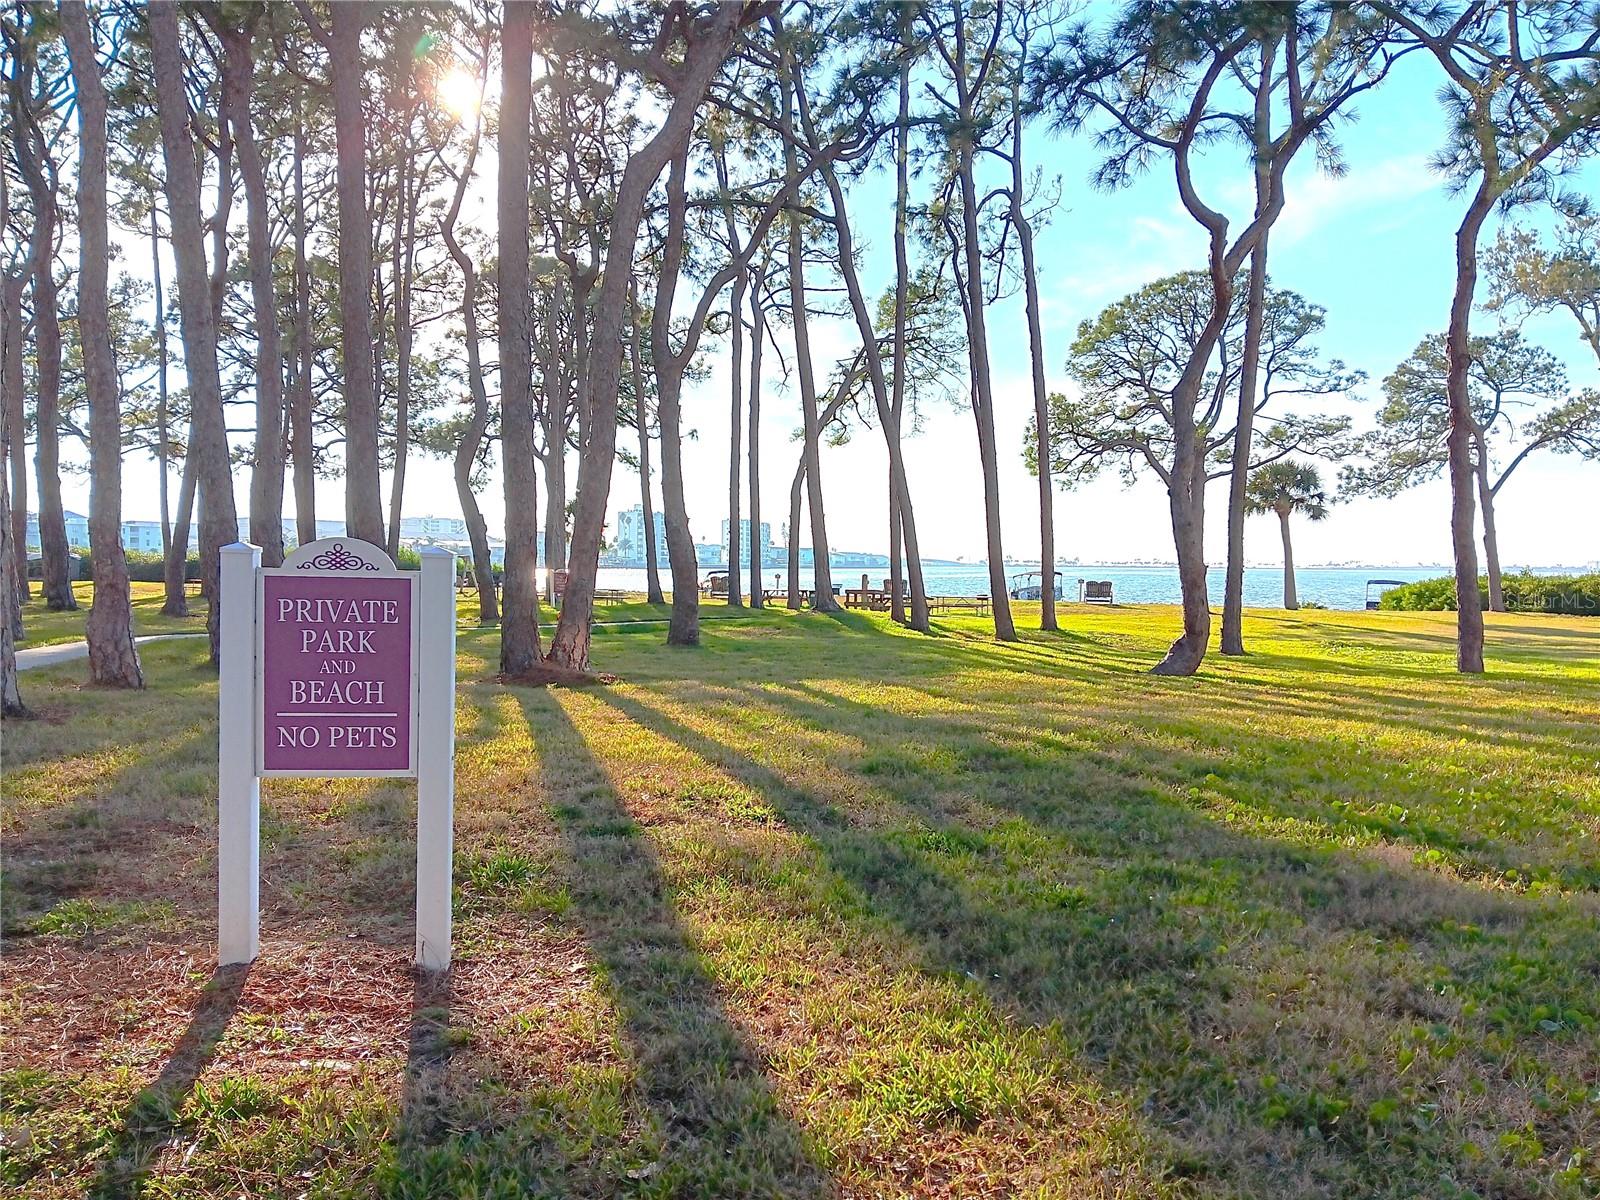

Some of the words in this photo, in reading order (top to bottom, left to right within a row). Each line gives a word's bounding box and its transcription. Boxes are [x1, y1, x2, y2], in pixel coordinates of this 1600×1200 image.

[277, 598, 399, 624] PRIVATE
[300, 630, 376, 654] PARK
[319, 660, 356, 674] AND
[289, 680, 385, 704] BEACH
[277, 726, 320, 748] NO
[328, 726, 397, 748] PETS
